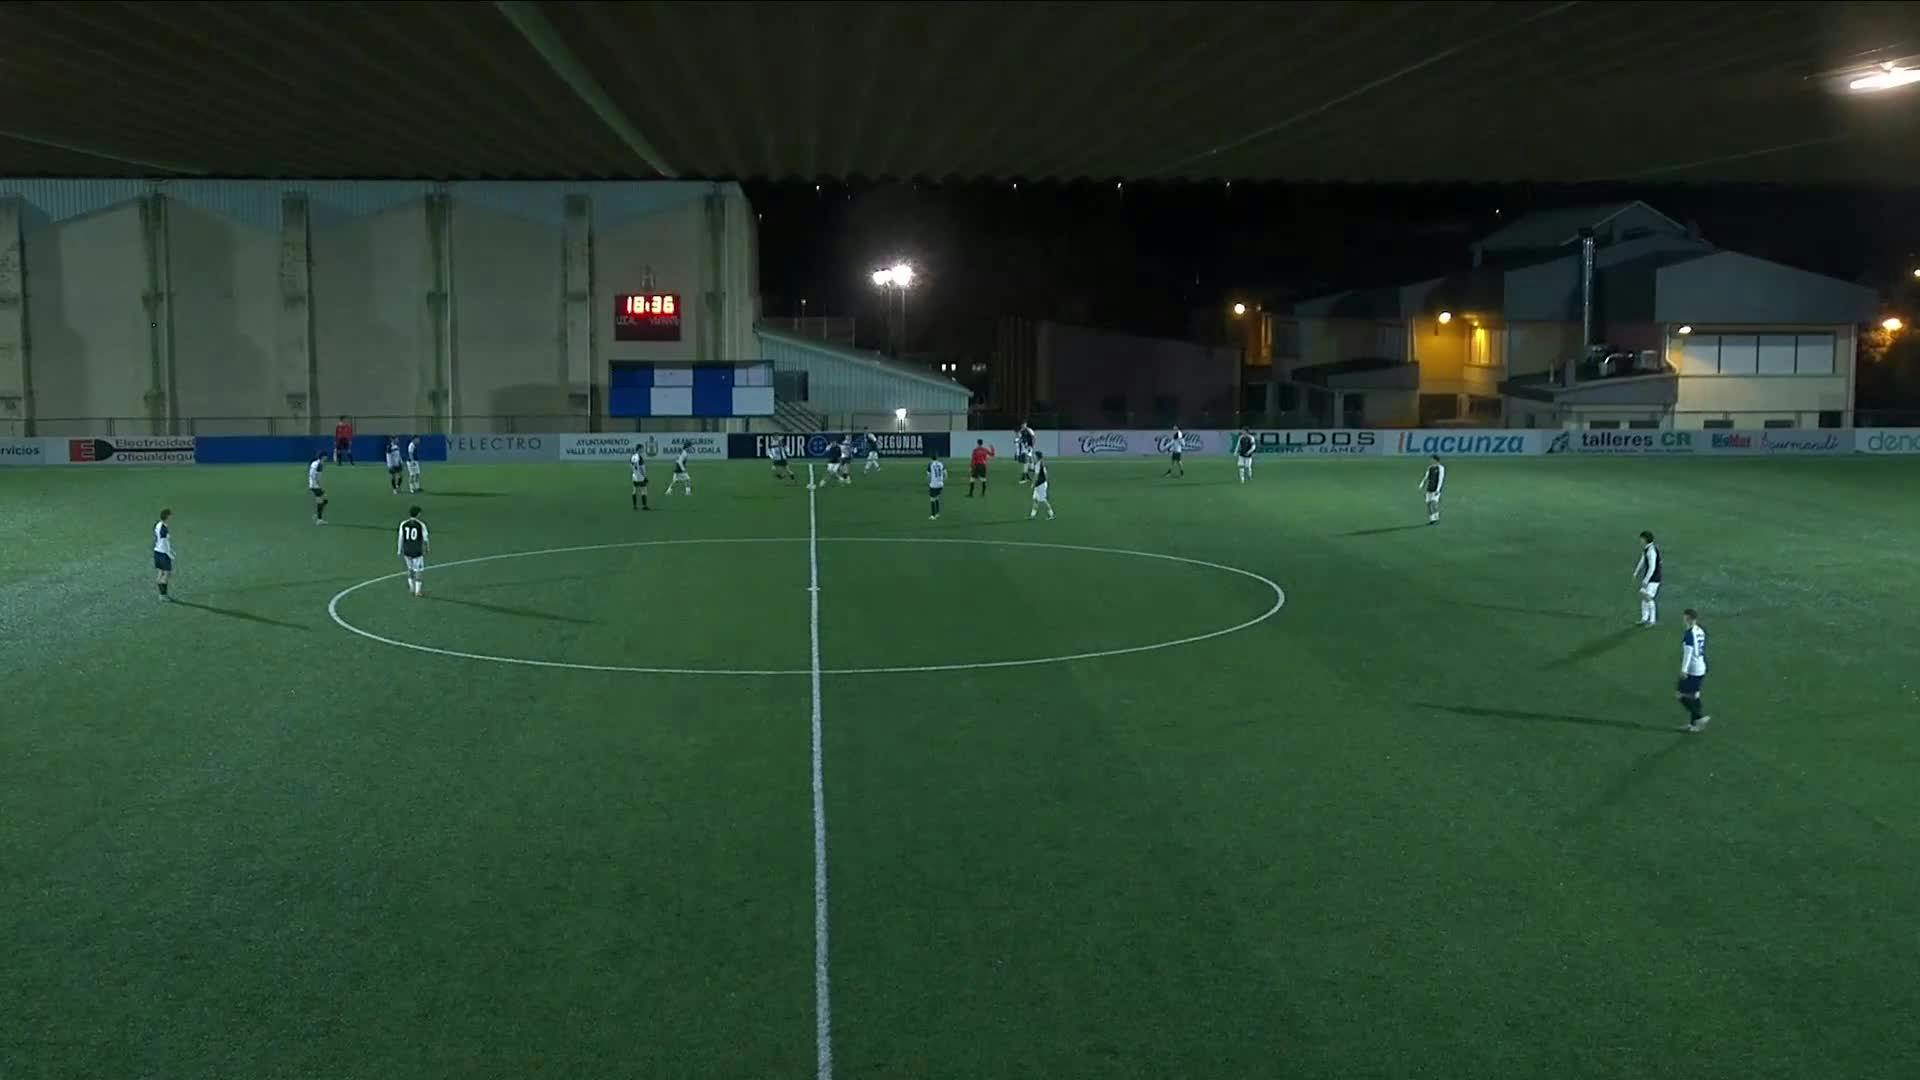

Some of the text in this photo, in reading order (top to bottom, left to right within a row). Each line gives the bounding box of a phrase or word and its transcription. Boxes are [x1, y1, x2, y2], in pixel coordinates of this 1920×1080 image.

[627, 296, 675, 314] 18:36
[876, 435, 923, 449] SEGUNDA
[1252, 432, 1376, 446] OLDOS
[1406, 432, 1525, 453] Lacunza
[1582, 432, 1692, 447] talleres CR
[405, 526, 418, 541] 10
